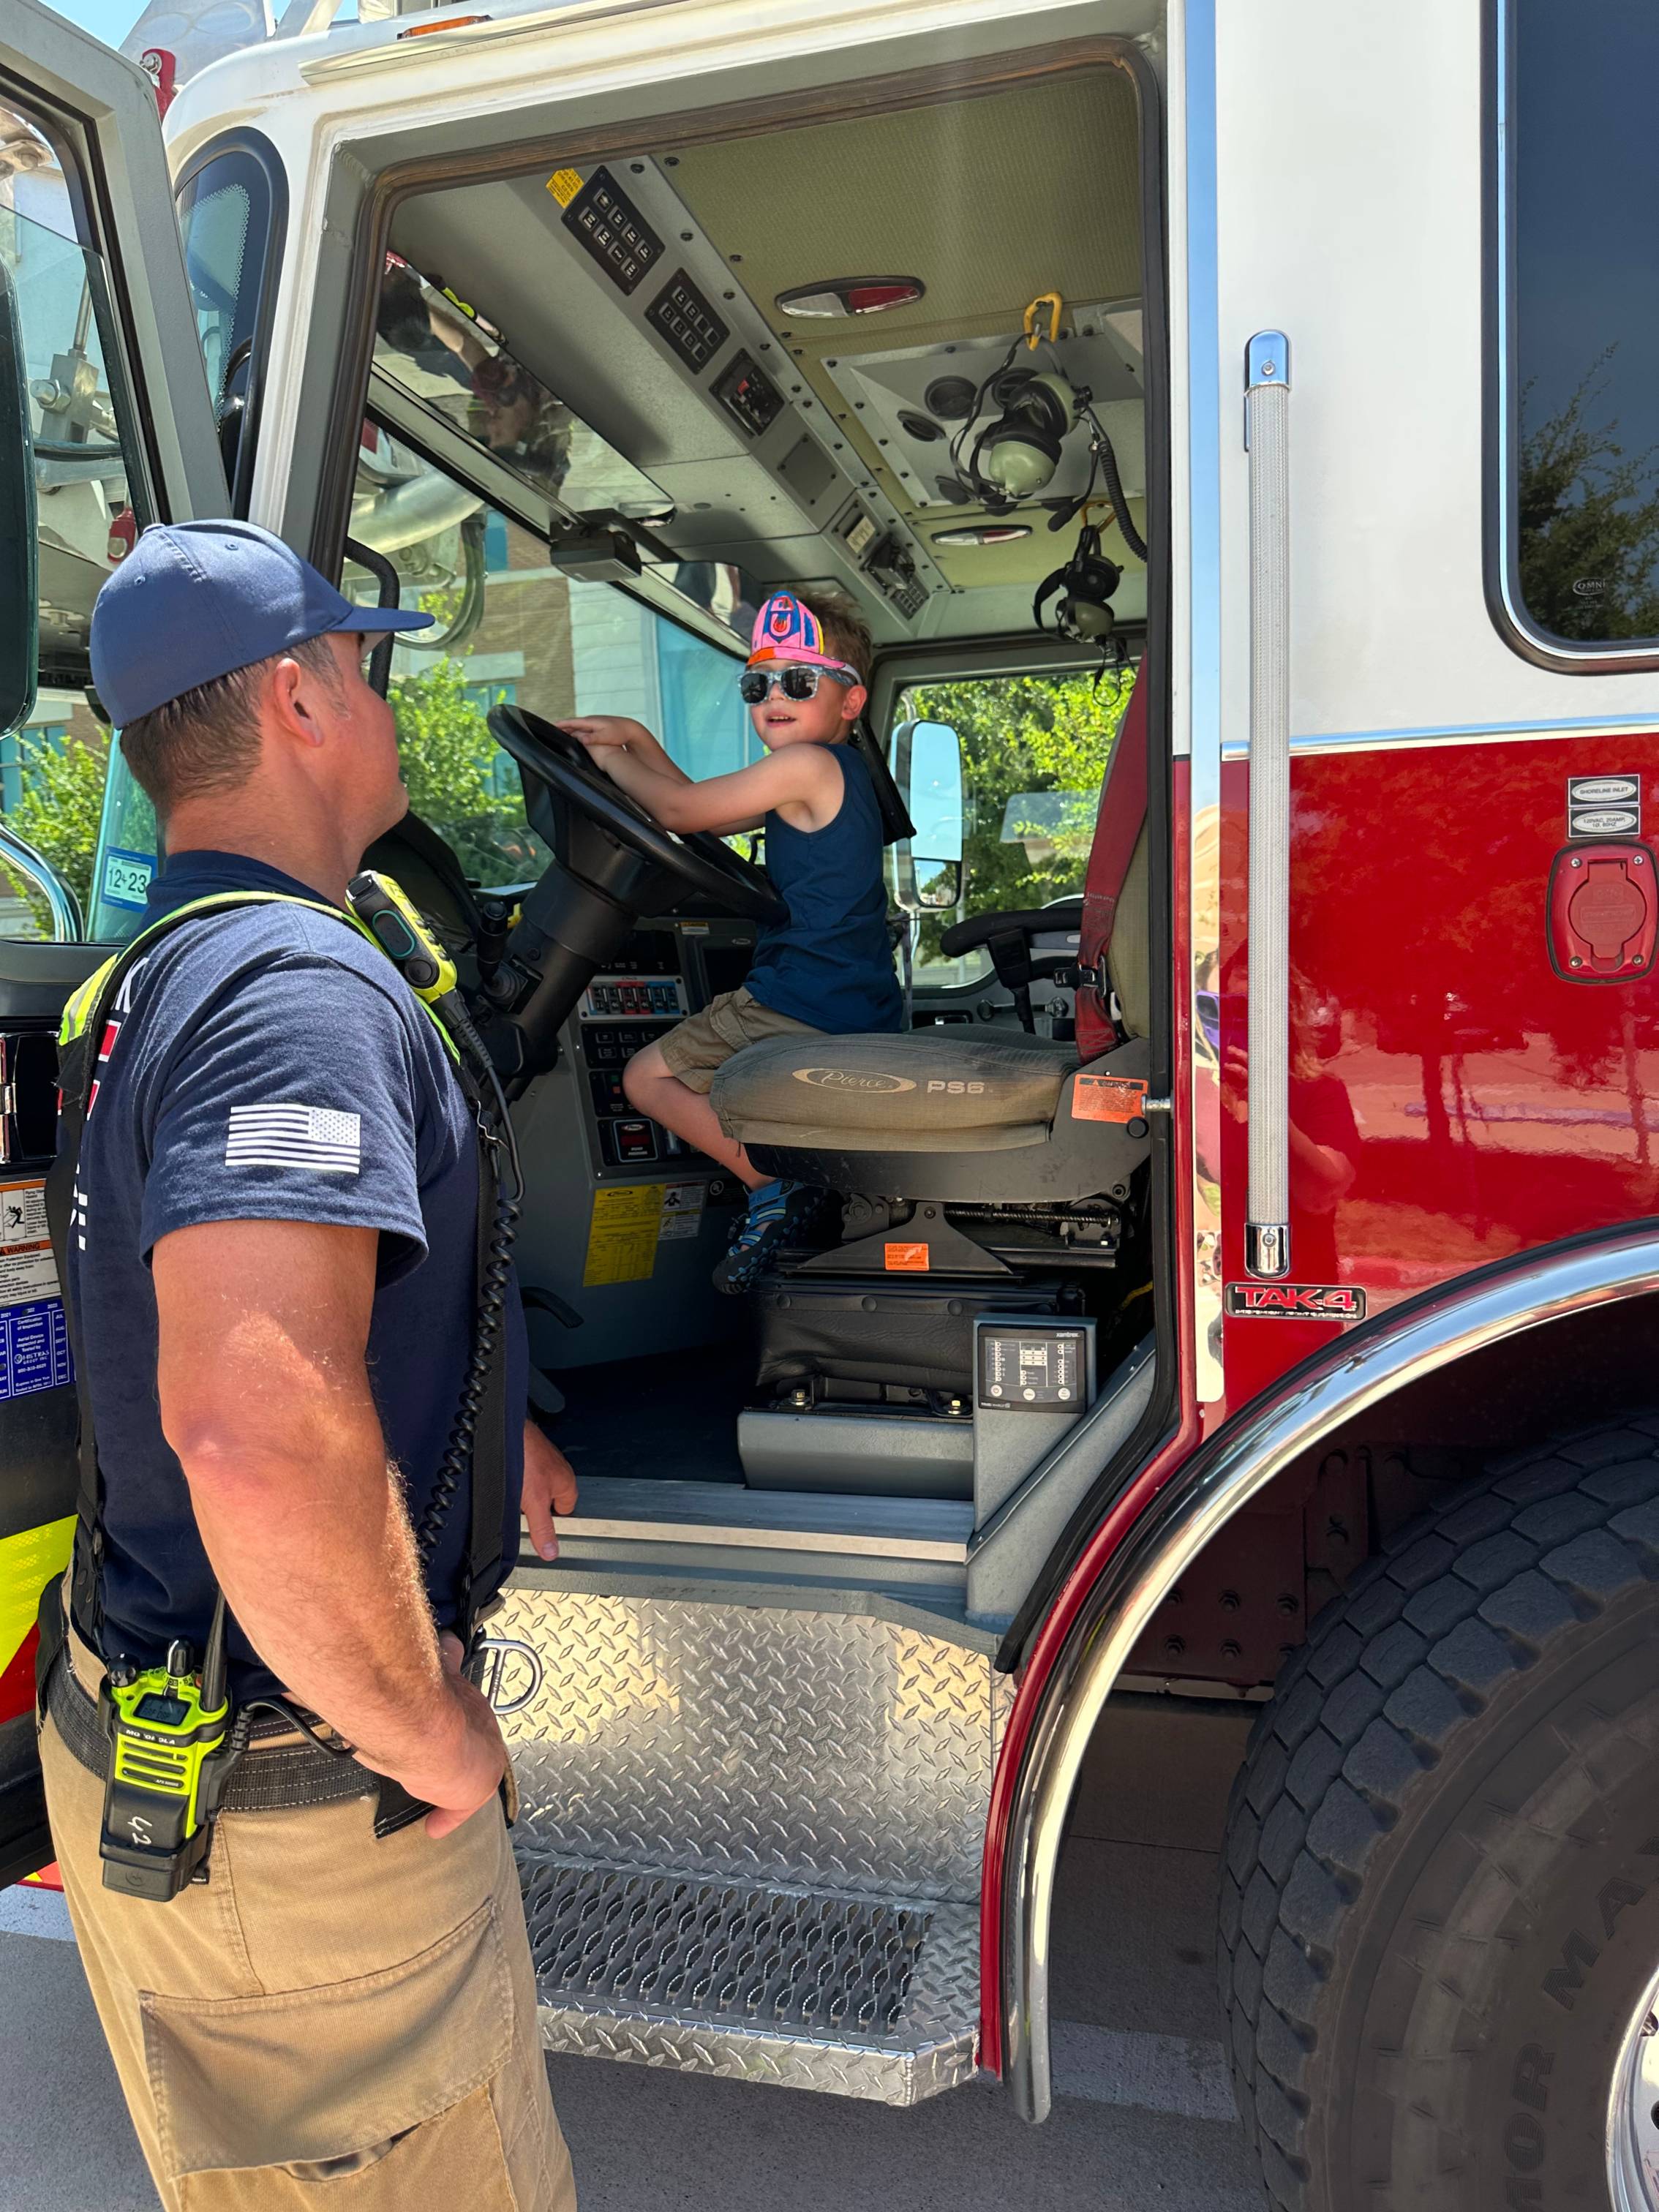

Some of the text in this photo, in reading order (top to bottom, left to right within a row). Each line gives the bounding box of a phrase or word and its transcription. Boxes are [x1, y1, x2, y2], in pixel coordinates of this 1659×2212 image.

[108, 867, 147, 894] 12 23
[821, 1070, 985, 1094] Pierce PS6
[7, 1242, 41, 1253] WARNING
[1235, 1286, 1357, 1312] TAK-4
